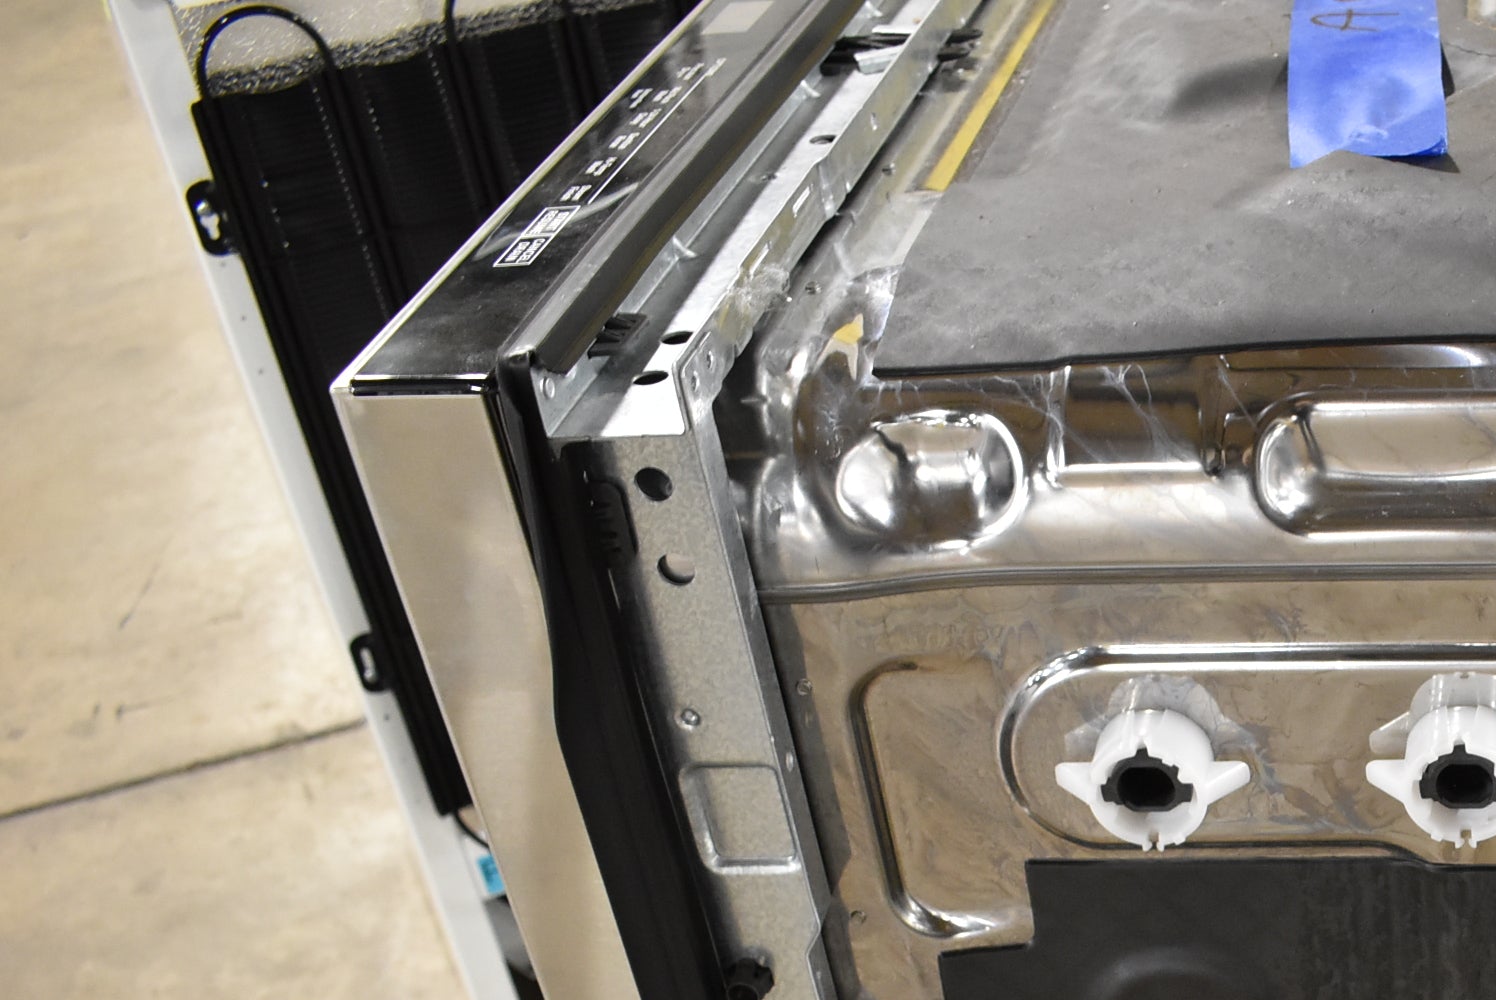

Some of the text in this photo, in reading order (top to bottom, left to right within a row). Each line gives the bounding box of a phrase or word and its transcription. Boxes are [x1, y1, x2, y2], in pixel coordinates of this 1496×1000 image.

[1310, 0, 1400, 32] A
[540, 211, 570, 232] START
[504, 241, 531, 262] DRAIN
[516, 238, 546, 263] CANCEL
